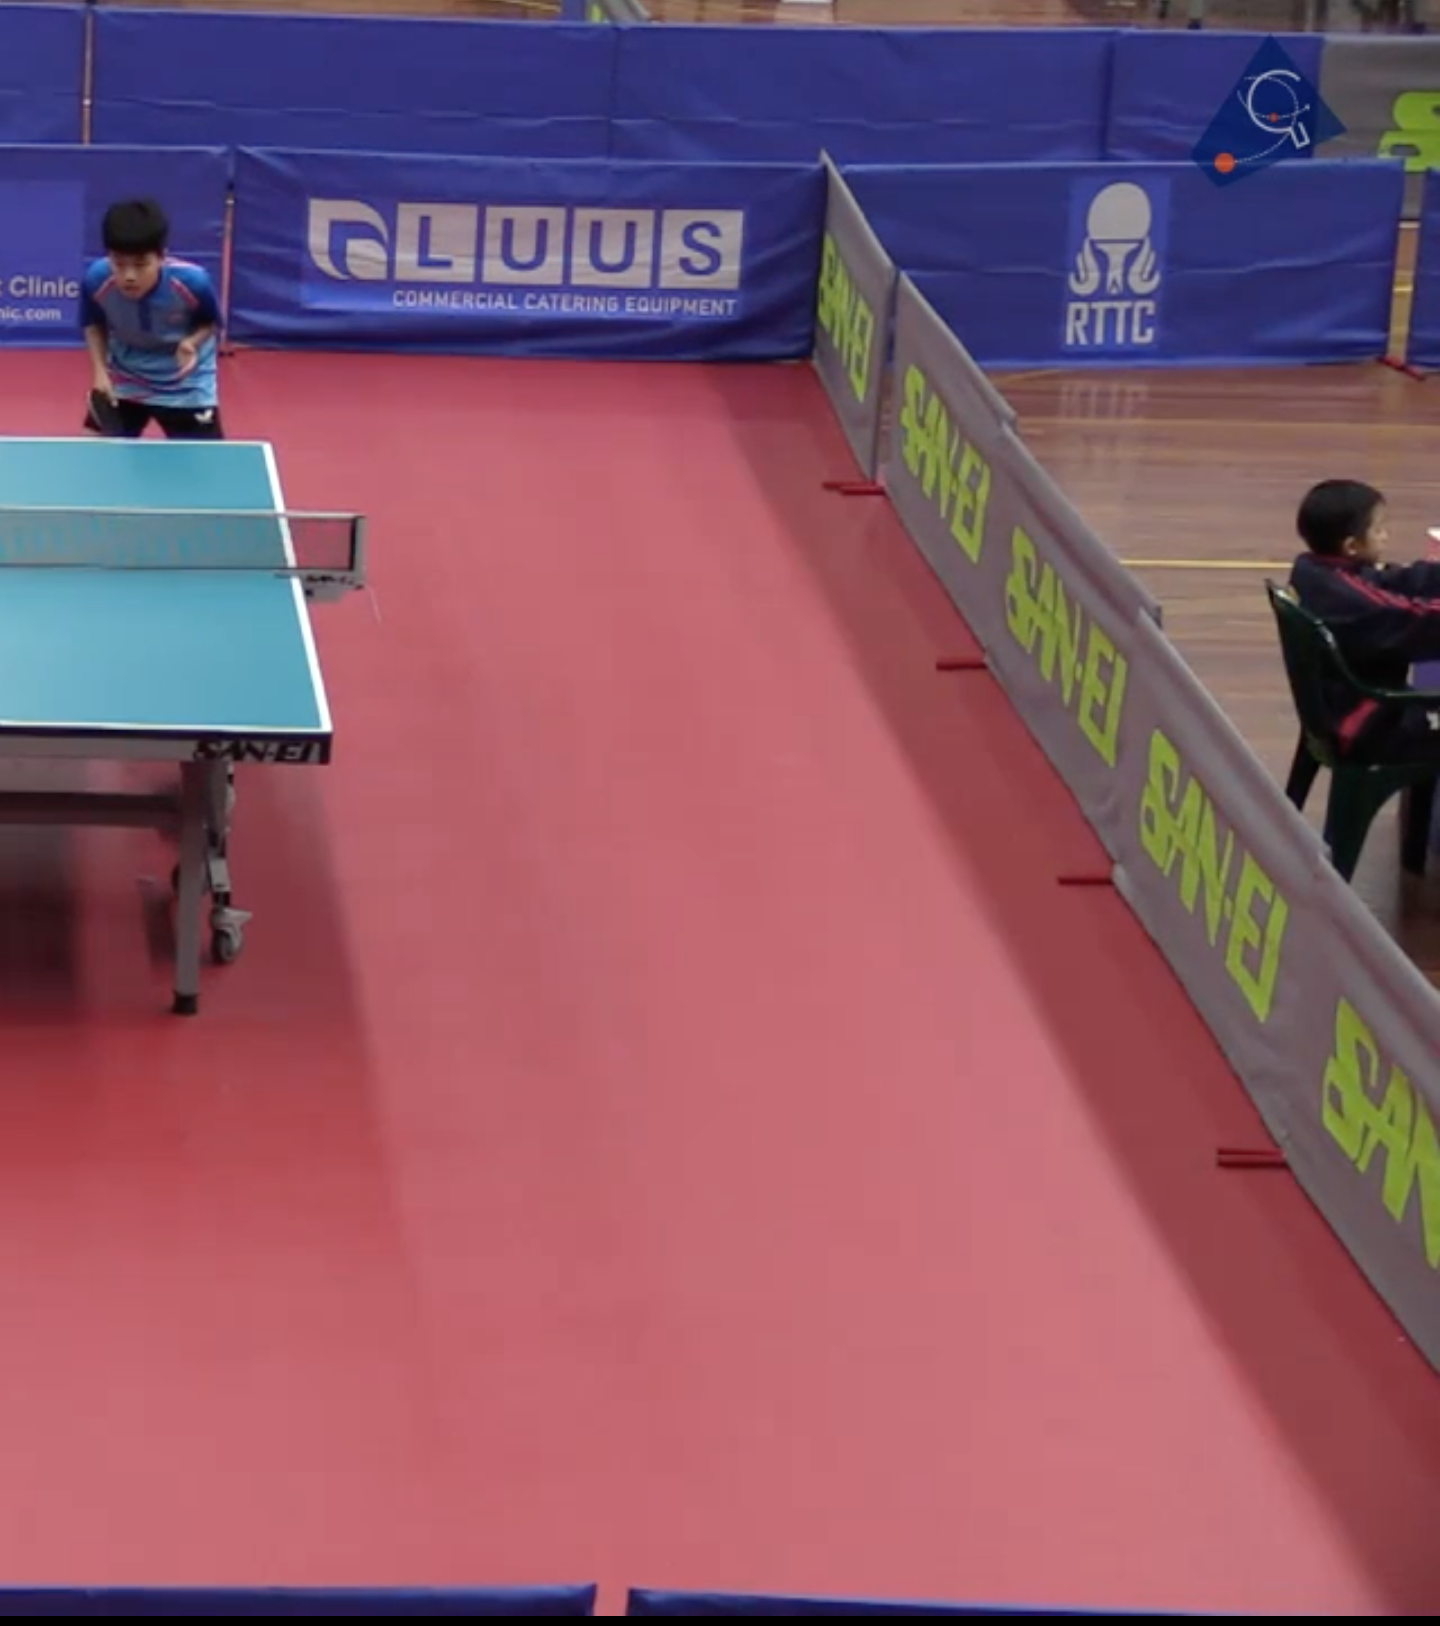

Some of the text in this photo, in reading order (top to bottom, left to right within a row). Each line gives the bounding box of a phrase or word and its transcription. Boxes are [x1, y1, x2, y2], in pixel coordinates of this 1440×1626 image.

[416, 213, 725, 278] LUUS
[9, 275, 80, 298] Clinic
[392, 290, 738, 317] COMMERCIAL CATERING EQUIPMENT
[1065, 300, 1156, 345] RTTC
[898, 363, 992, 565] SAN-EI
[1004, 525, 1128, 768] SAN-EI
[1139, 728, 1289, 1024] SAN-EI
